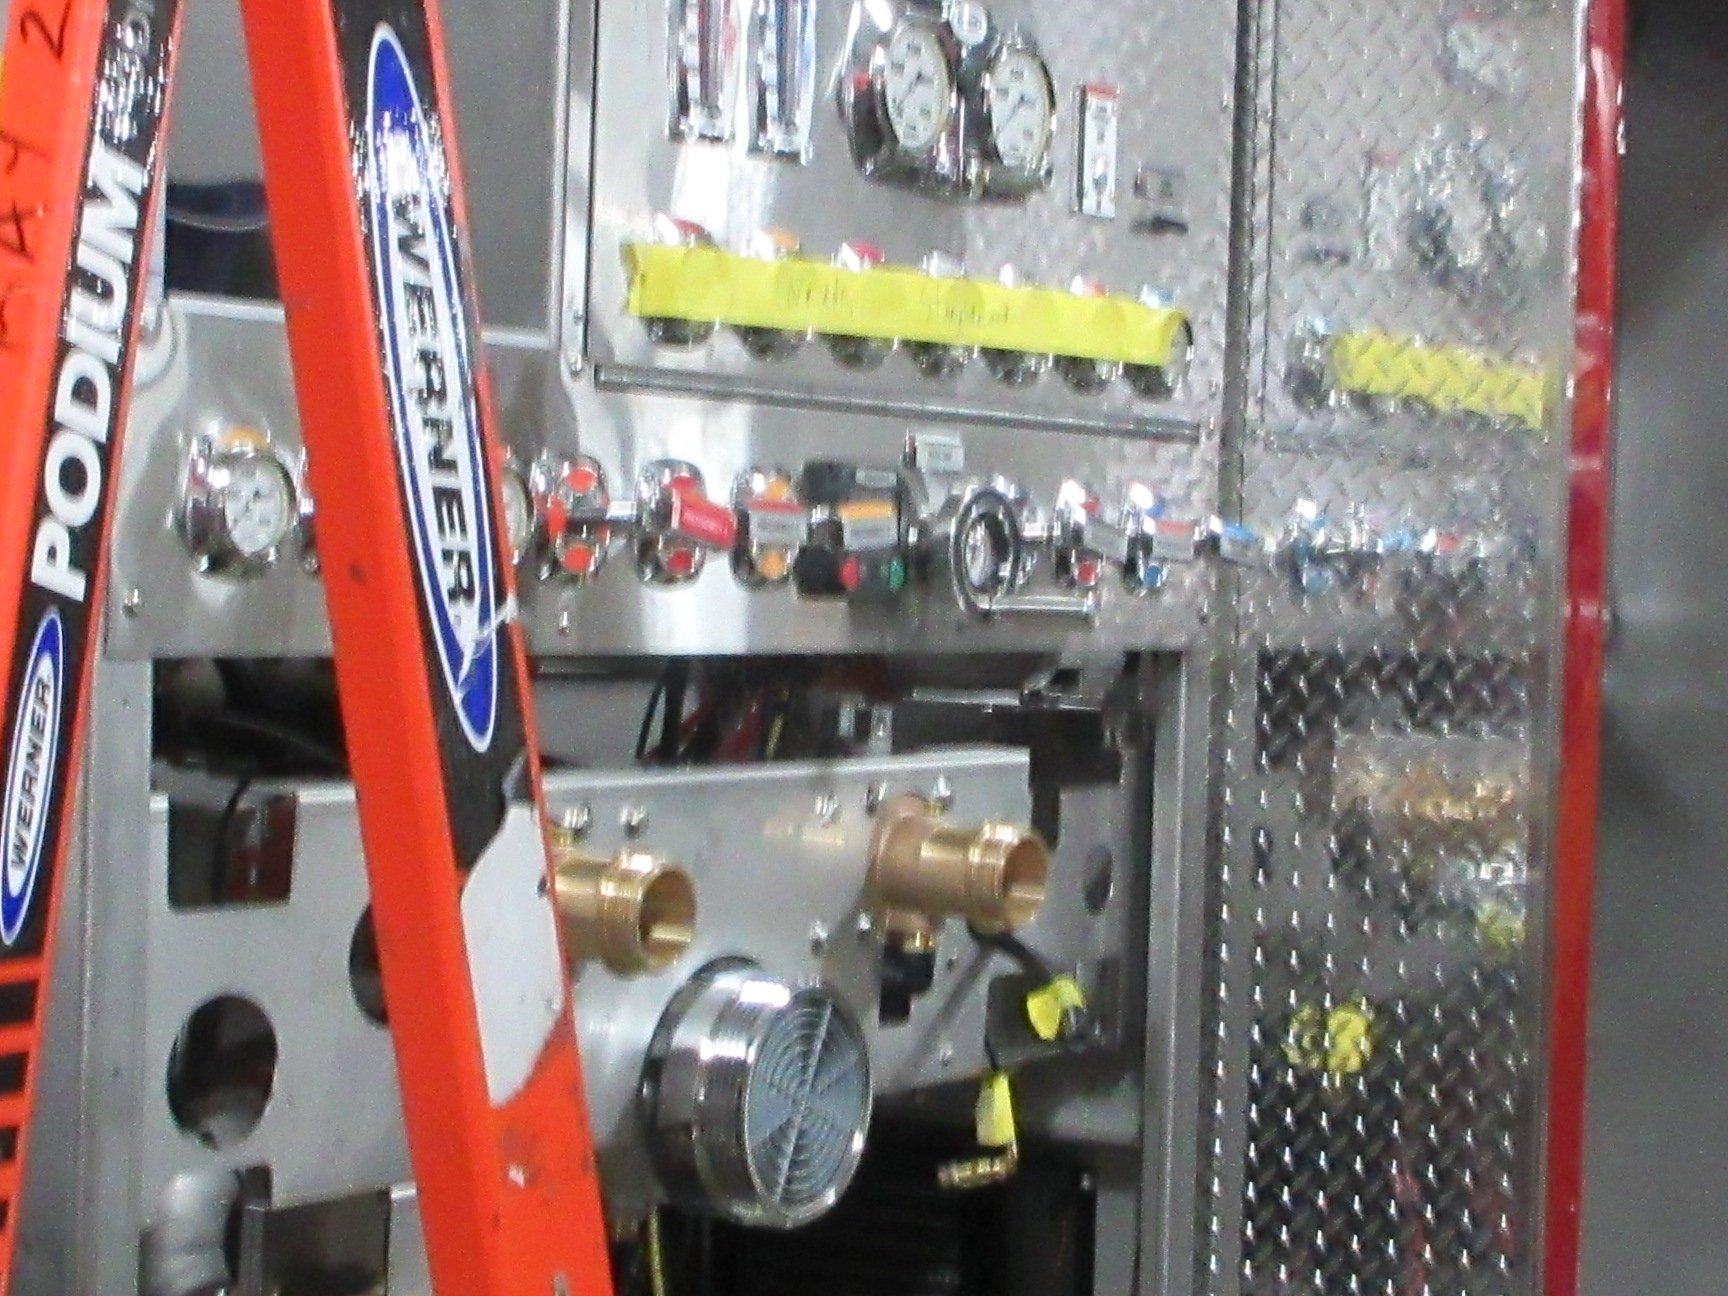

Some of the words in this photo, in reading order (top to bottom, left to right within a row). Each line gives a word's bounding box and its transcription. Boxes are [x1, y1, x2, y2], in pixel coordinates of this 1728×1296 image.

[31, 144, 148, 604] PODIUM
[392, 182, 477, 614] WERNER
[10, 675, 53, 873] WERNER
